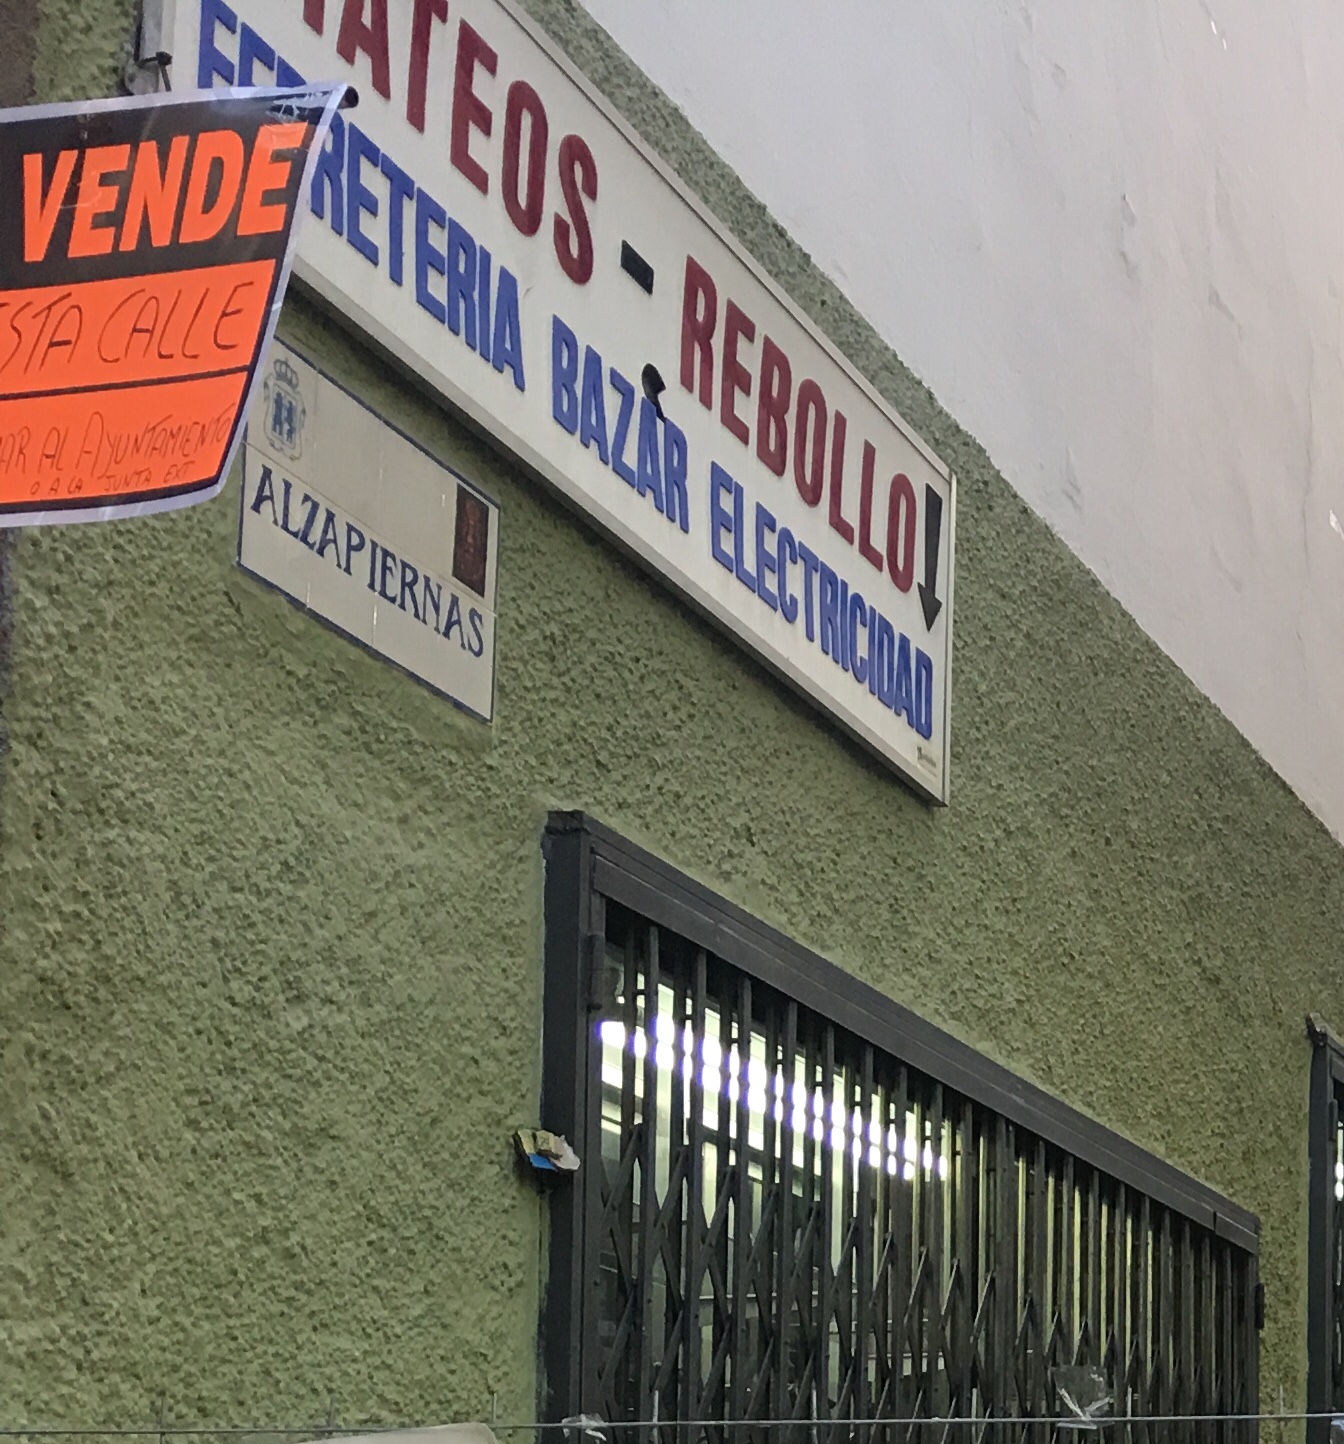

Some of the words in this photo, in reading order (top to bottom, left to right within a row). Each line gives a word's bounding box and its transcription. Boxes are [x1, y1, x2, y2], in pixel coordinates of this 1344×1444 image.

[23, 121, 308, 263] VENDE
[0, 293, 83, 376] STA
[97, 281, 254, 364] CALLE
[303, 0, 597, 286] ATEOS
[680, 254, 917, 594] REBOLLO
[75, 403, 236, 478] AYUNTAMIENTO
[198, 0, 524, 392] FERETERIA
[551, 313, 690, 534] BAZAR
[711, 460, 933, 740] ELECTRICIDAD
[103, 470, 152, 492] JUNTA
[163, 460, 196, 483] EXT
[250, 463, 484, 658] ALZAPIERNAS
